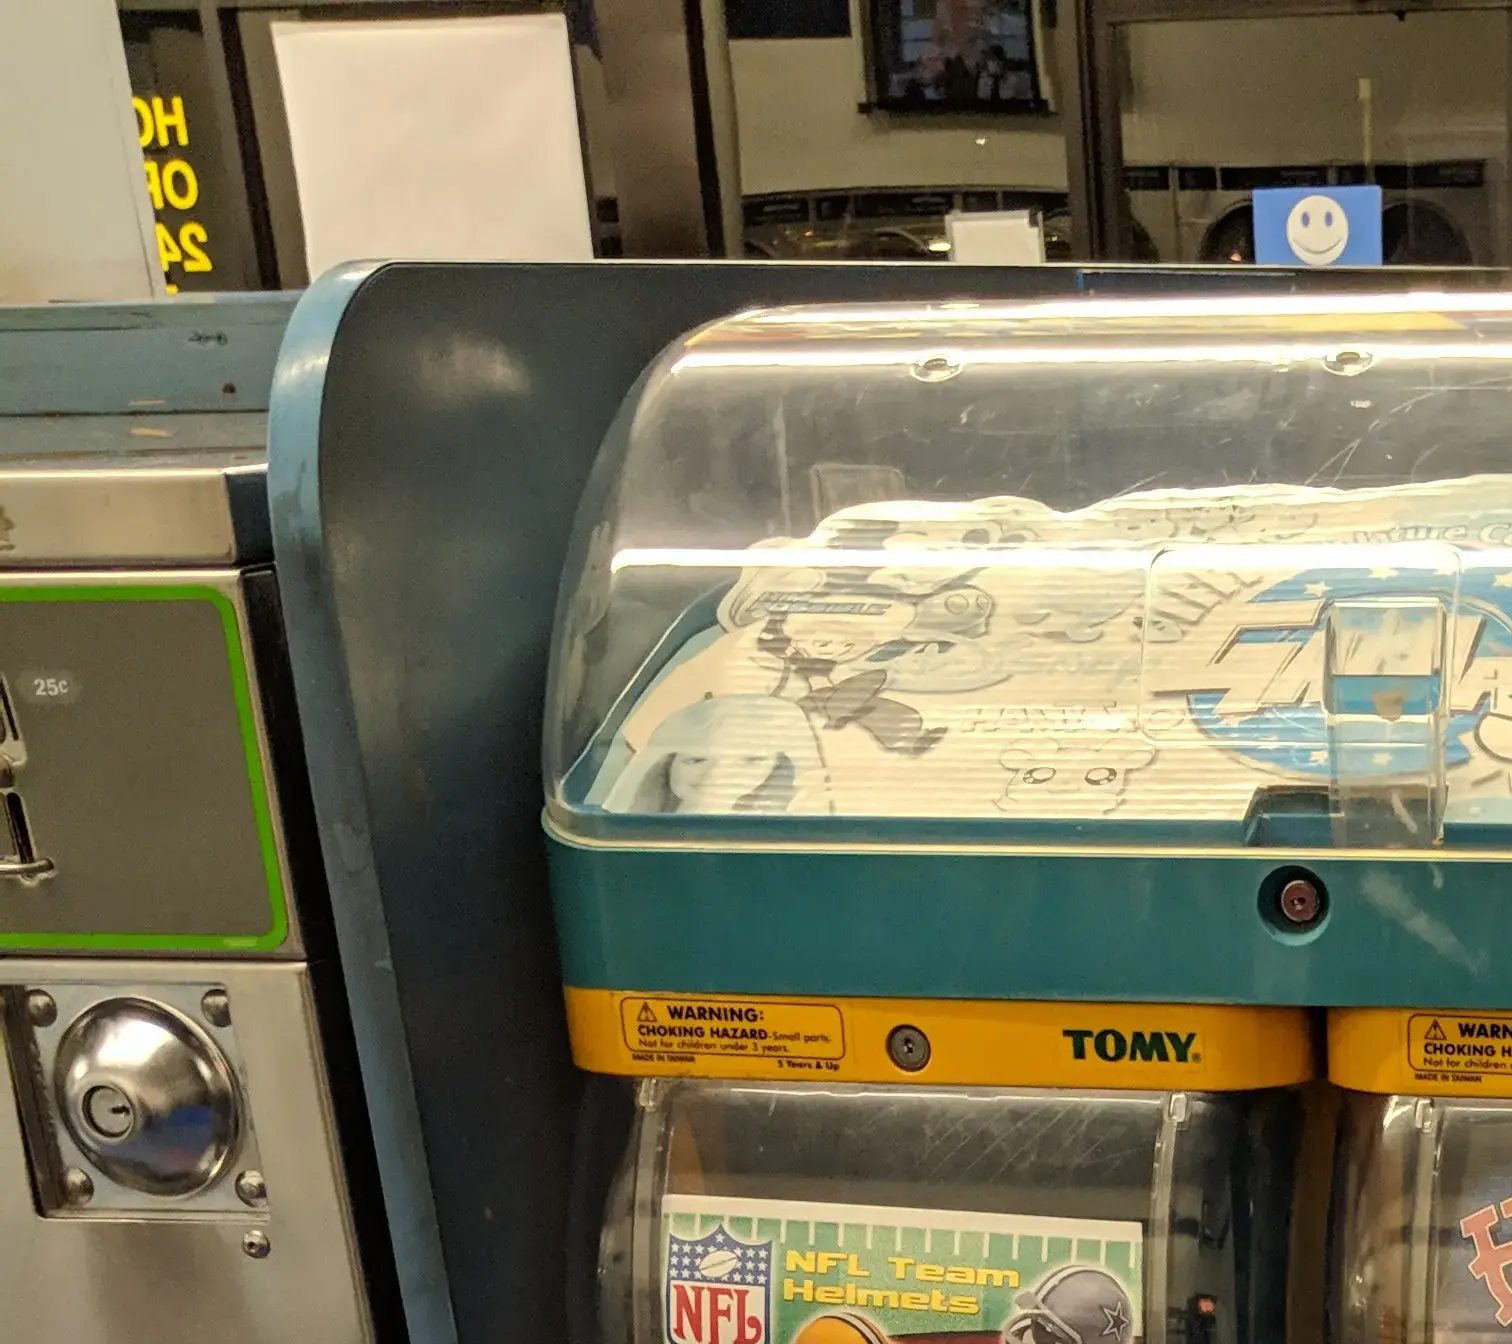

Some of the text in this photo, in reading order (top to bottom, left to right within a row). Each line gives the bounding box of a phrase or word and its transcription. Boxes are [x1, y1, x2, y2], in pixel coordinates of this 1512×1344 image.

[667, 1005, 764, 1023] WARNING:
[637, 1024, 705, 1038] CHOKING
[638, 1039, 658, 1049] Not
[677, 1040, 717, 1050] children
[720, 1042, 749, 1052] under
[1423, 1043, 1496, 1056] CHOKING
[786, 1060, 812, 1070] Years
[815, 1061, 822, 1070] &
[825, 1061, 839, 1072] Up
[1423, 1057, 1444, 1067] Not
[1464, 1058, 1507, 1069] children
[1415, 1073, 1438, 1081] MADE
[1451, 1074, 1482, 1082] TAIWAN
[786, 1249, 1020, 1289] NFL Team
[783, 1277, 982, 1316] Helmets
